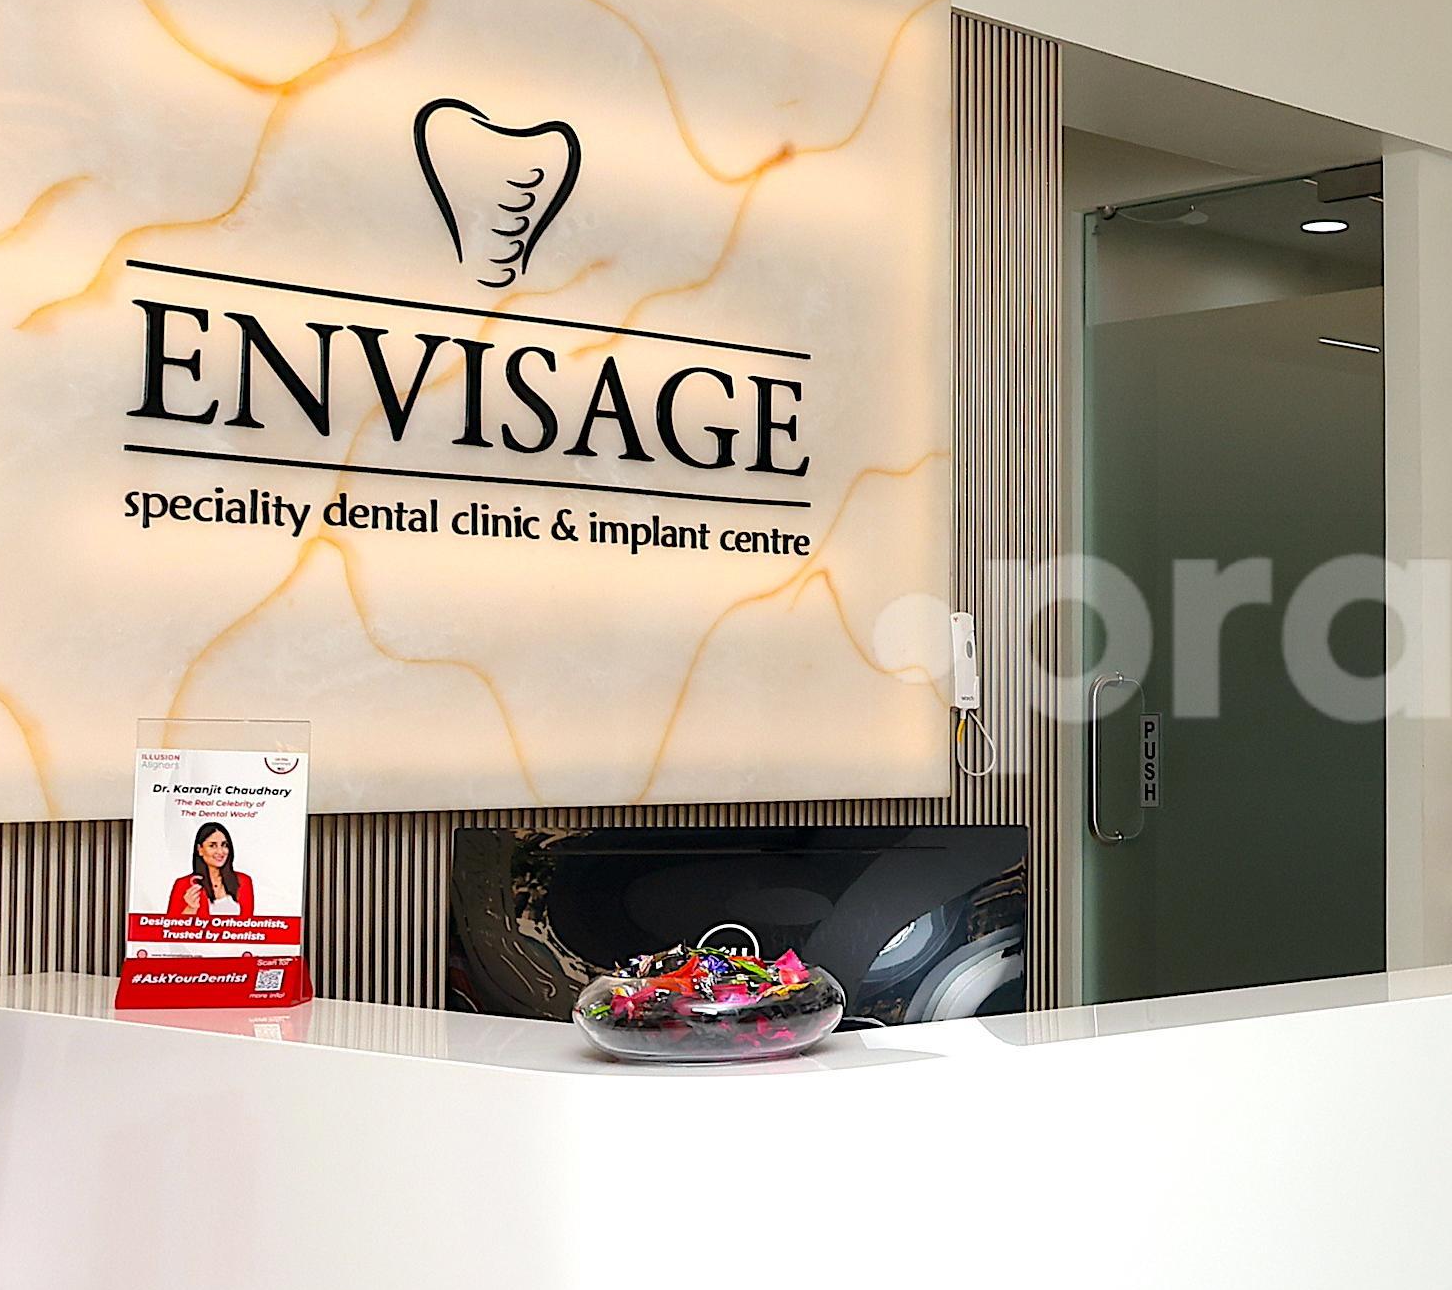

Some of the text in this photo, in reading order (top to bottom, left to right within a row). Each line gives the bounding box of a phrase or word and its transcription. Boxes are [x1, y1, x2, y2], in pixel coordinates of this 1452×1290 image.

[126, 300, 810, 479] ENVISAGE
[124, 487, 811, 557] speciality dental clinic & implant centre
[1144, 721, 1156, 801] PUSH
[152, 784, 292, 797] Dr. Karanjit Chaudhary
[216, 800, 254, 808] Celebrity
[140, 917, 289, 929] Designed by Orthodontists,
[163, 930, 266, 941] Trusted by Dentists
[132, 973, 248, 984] #AskYourDentist
